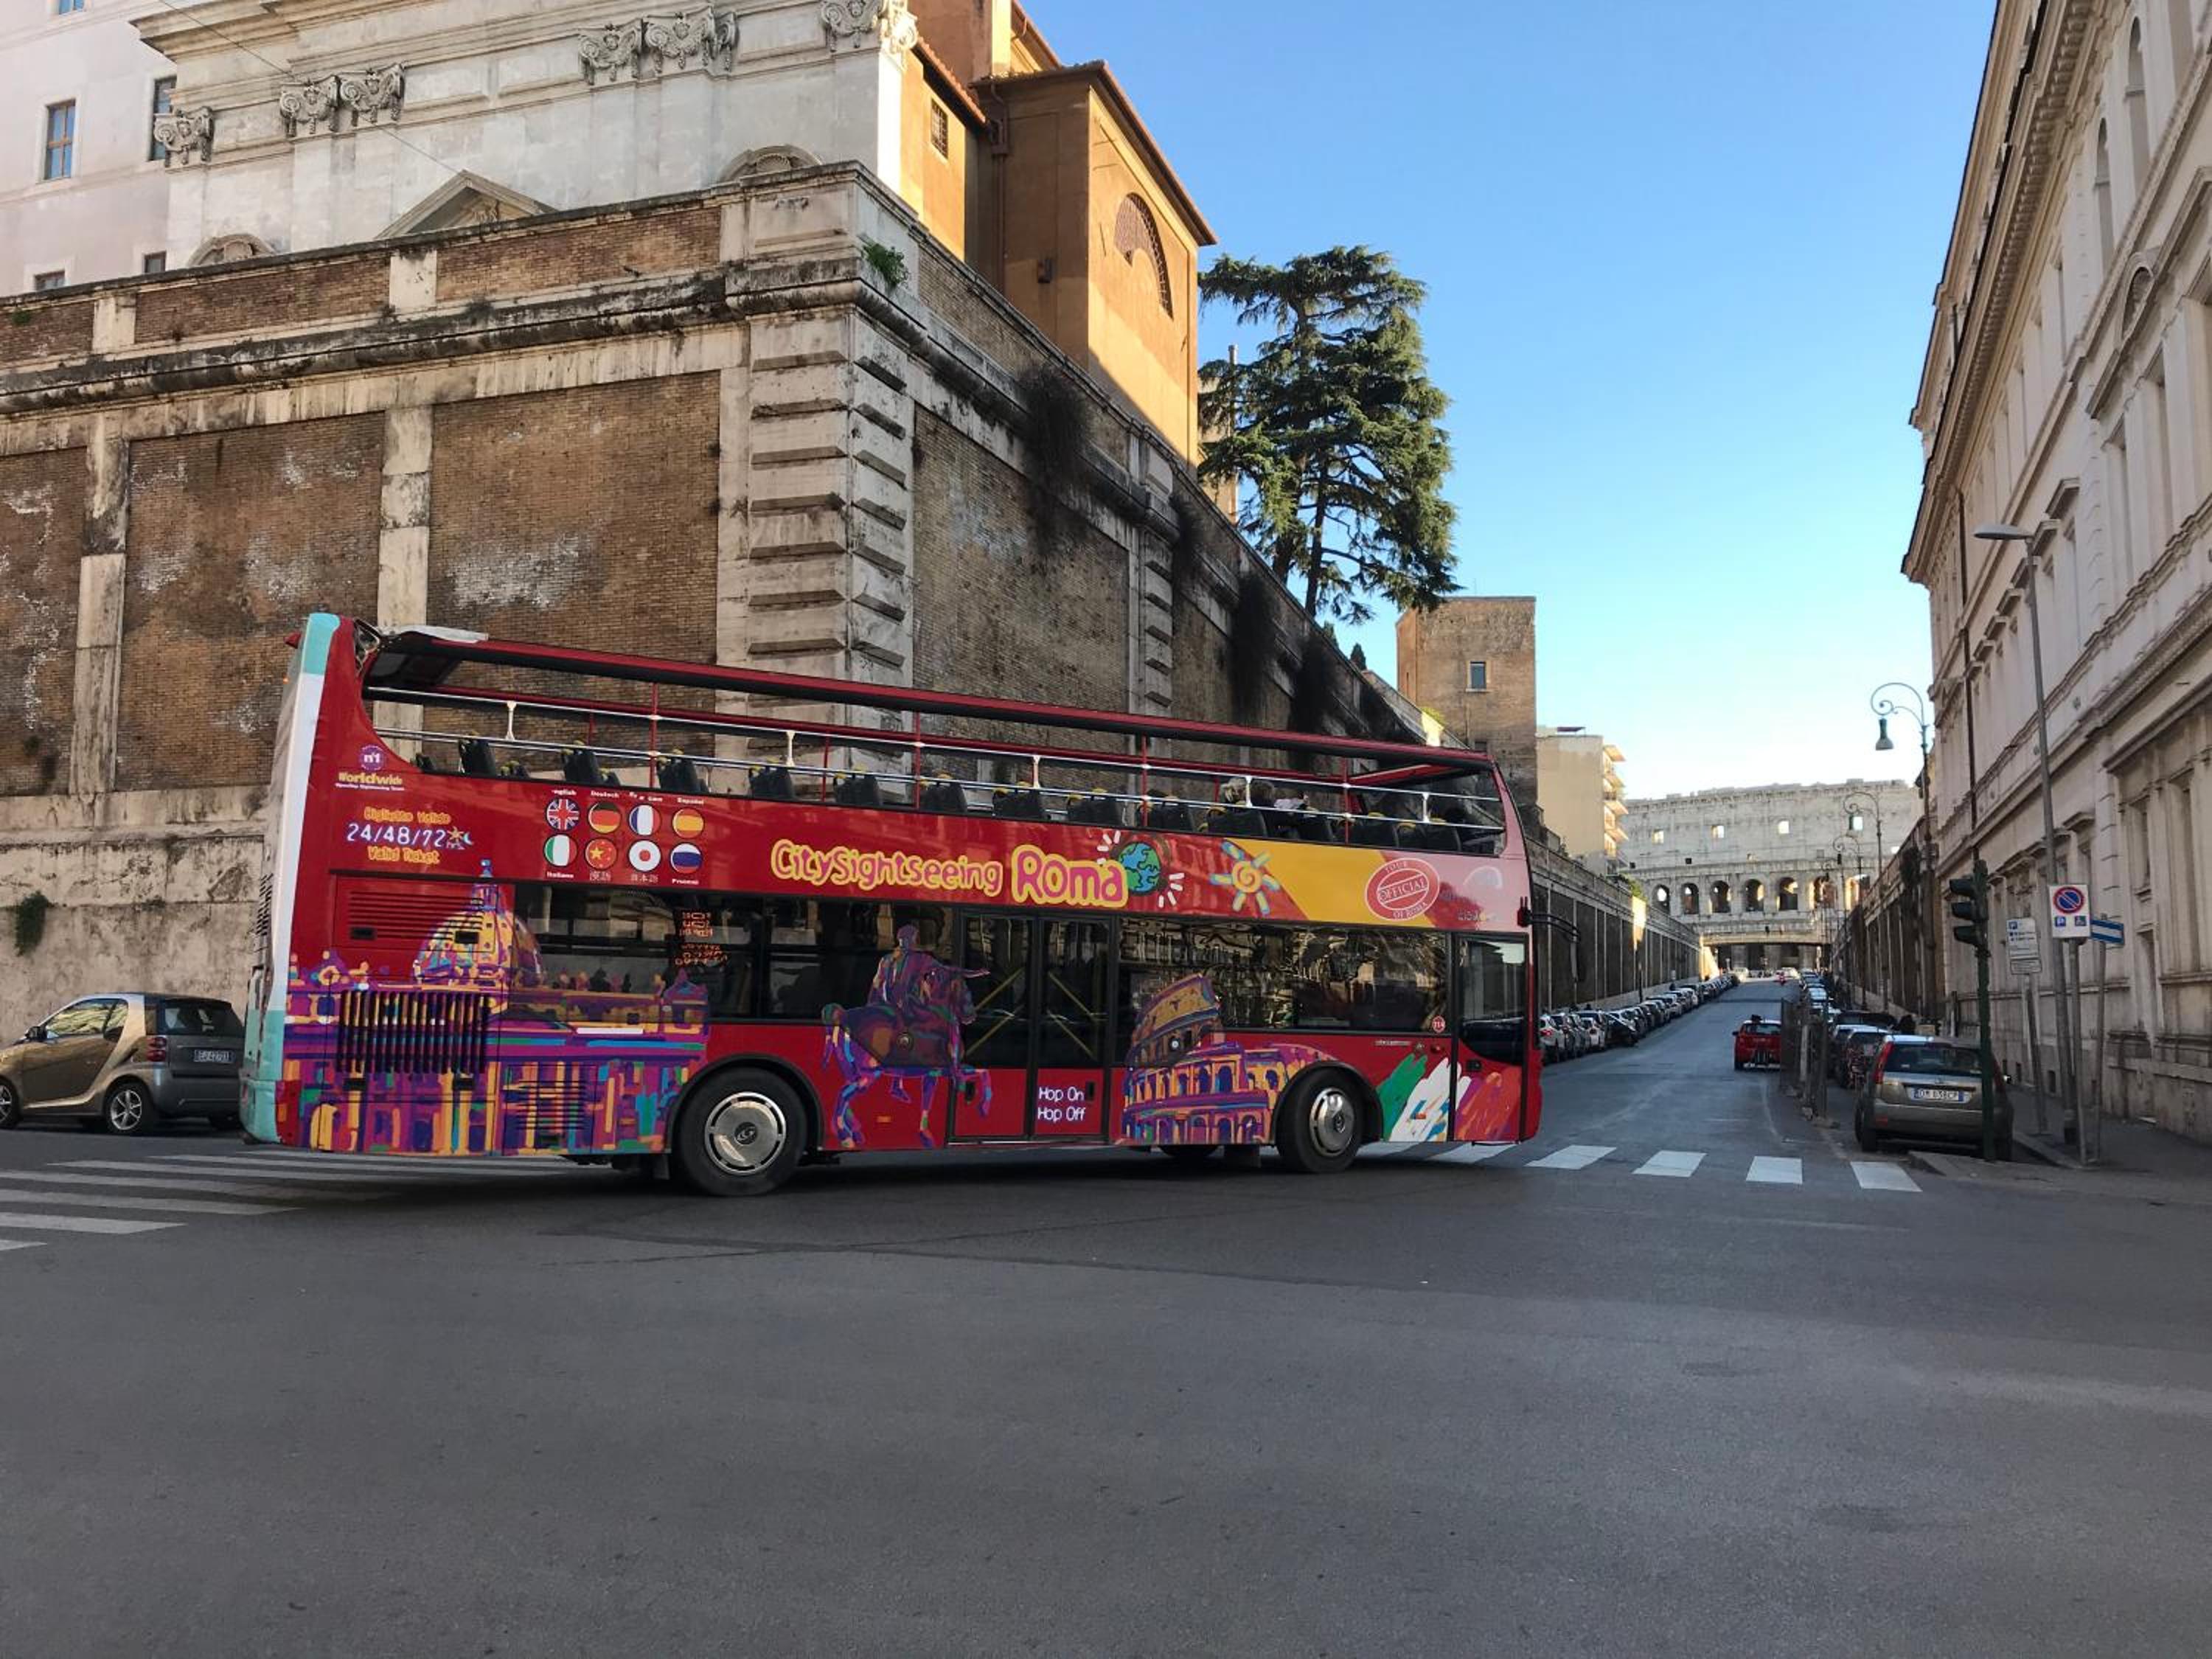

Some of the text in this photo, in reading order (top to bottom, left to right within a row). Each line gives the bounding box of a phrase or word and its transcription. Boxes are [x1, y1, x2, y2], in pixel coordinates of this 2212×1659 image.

[347, 823, 446, 848] 24/48/72
[367, 846, 400, 862] Valid
[1038, 1085, 1085, 1102] Hop On
[1037, 1106, 1086, 1124] Hop Off
